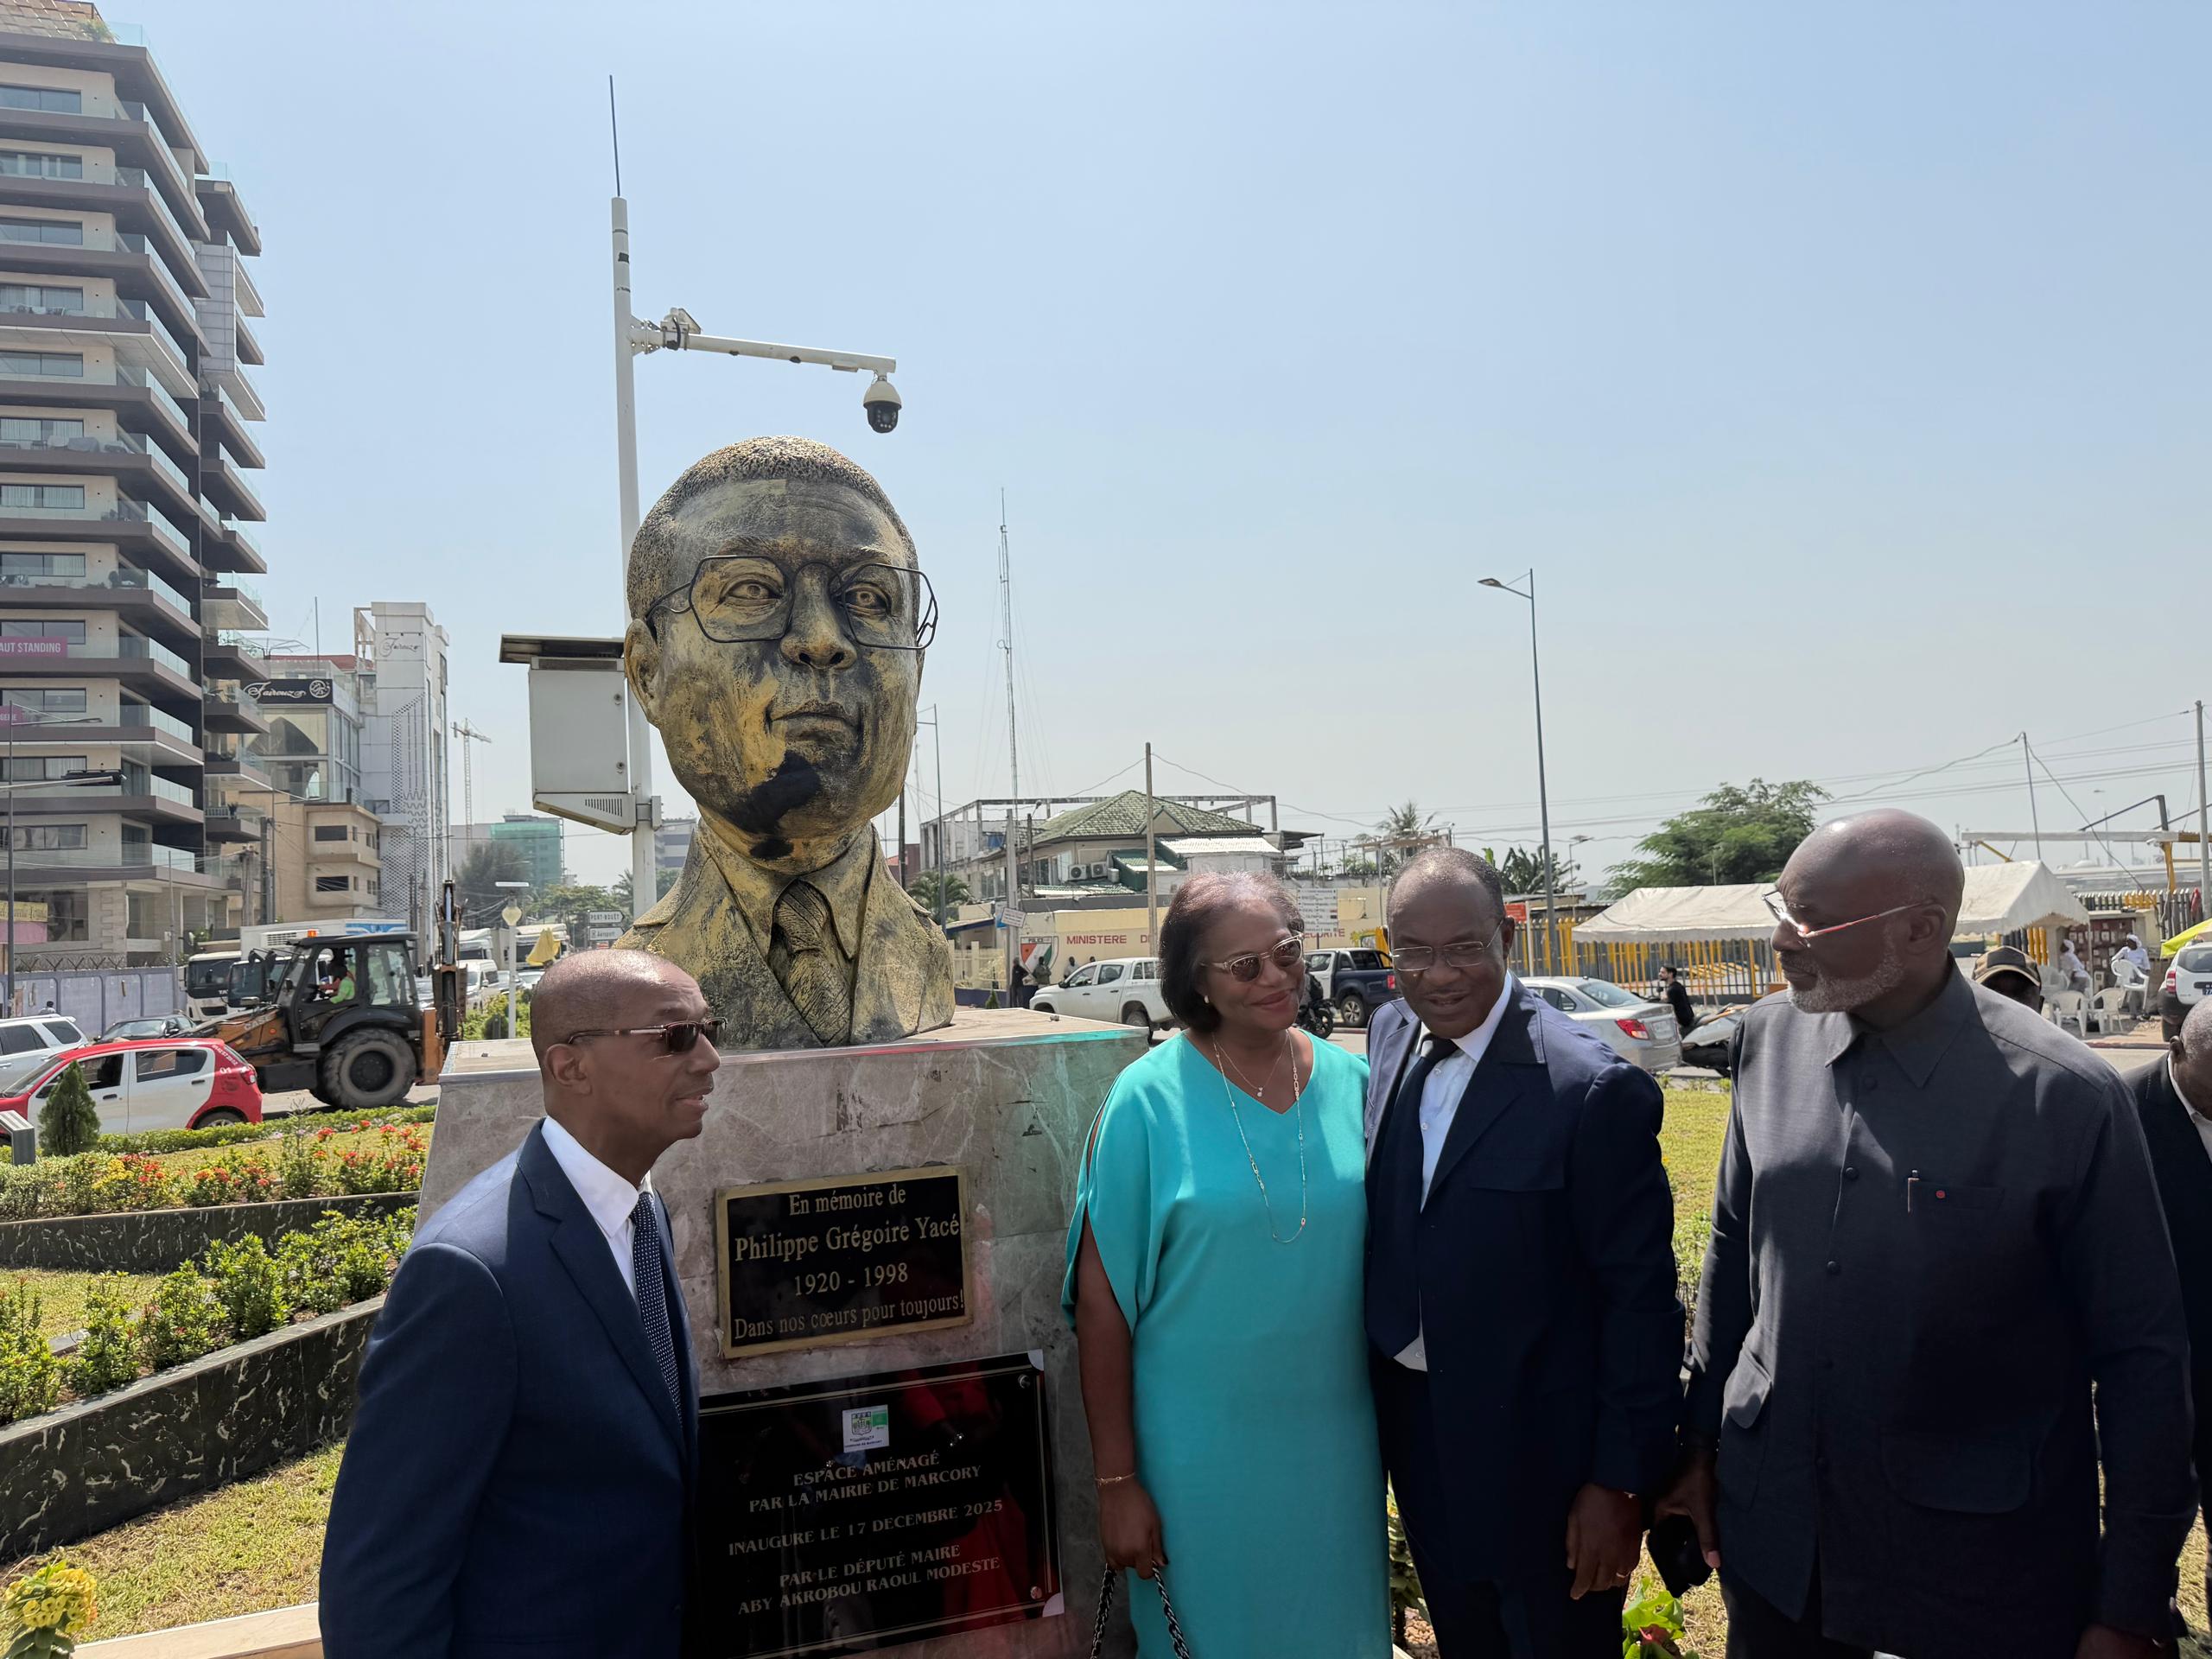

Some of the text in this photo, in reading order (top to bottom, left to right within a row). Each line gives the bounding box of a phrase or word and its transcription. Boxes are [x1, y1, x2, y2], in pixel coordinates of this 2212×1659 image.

[17, 643, 61, 653] STANDING
[1066, 935, 1127, 944] MINISTERE
[789, 1183, 906, 1216] En mémoire de
[734, 1213, 960, 1262] Philippe Grégoire Yacé
[794, 1271, 841, 1296] 1920
[864, 1262, 908, 1287] 1998
[734, 1318, 773, 1339] Dans
[779, 1316, 805, 1332] nos
[810, 1306, 857, 1328] cœurs
[862, 1304, 895, 1328] pour
[793, 1449, 940, 1486] ESPACE AMÉNAGÉ
[749, 1465, 981, 1512] PAR LA MAIRIE DE MARCORY
[728, 1499, 1003, 1556] INAUGURE LE 17 DECEMBRE 2025
[779, 1544, 960, 1587] PAR LE DÉPUTÉ MAIRE
[738, 1556, 1001, 1615] ABY AKROBOU RAOUL MODESTE
